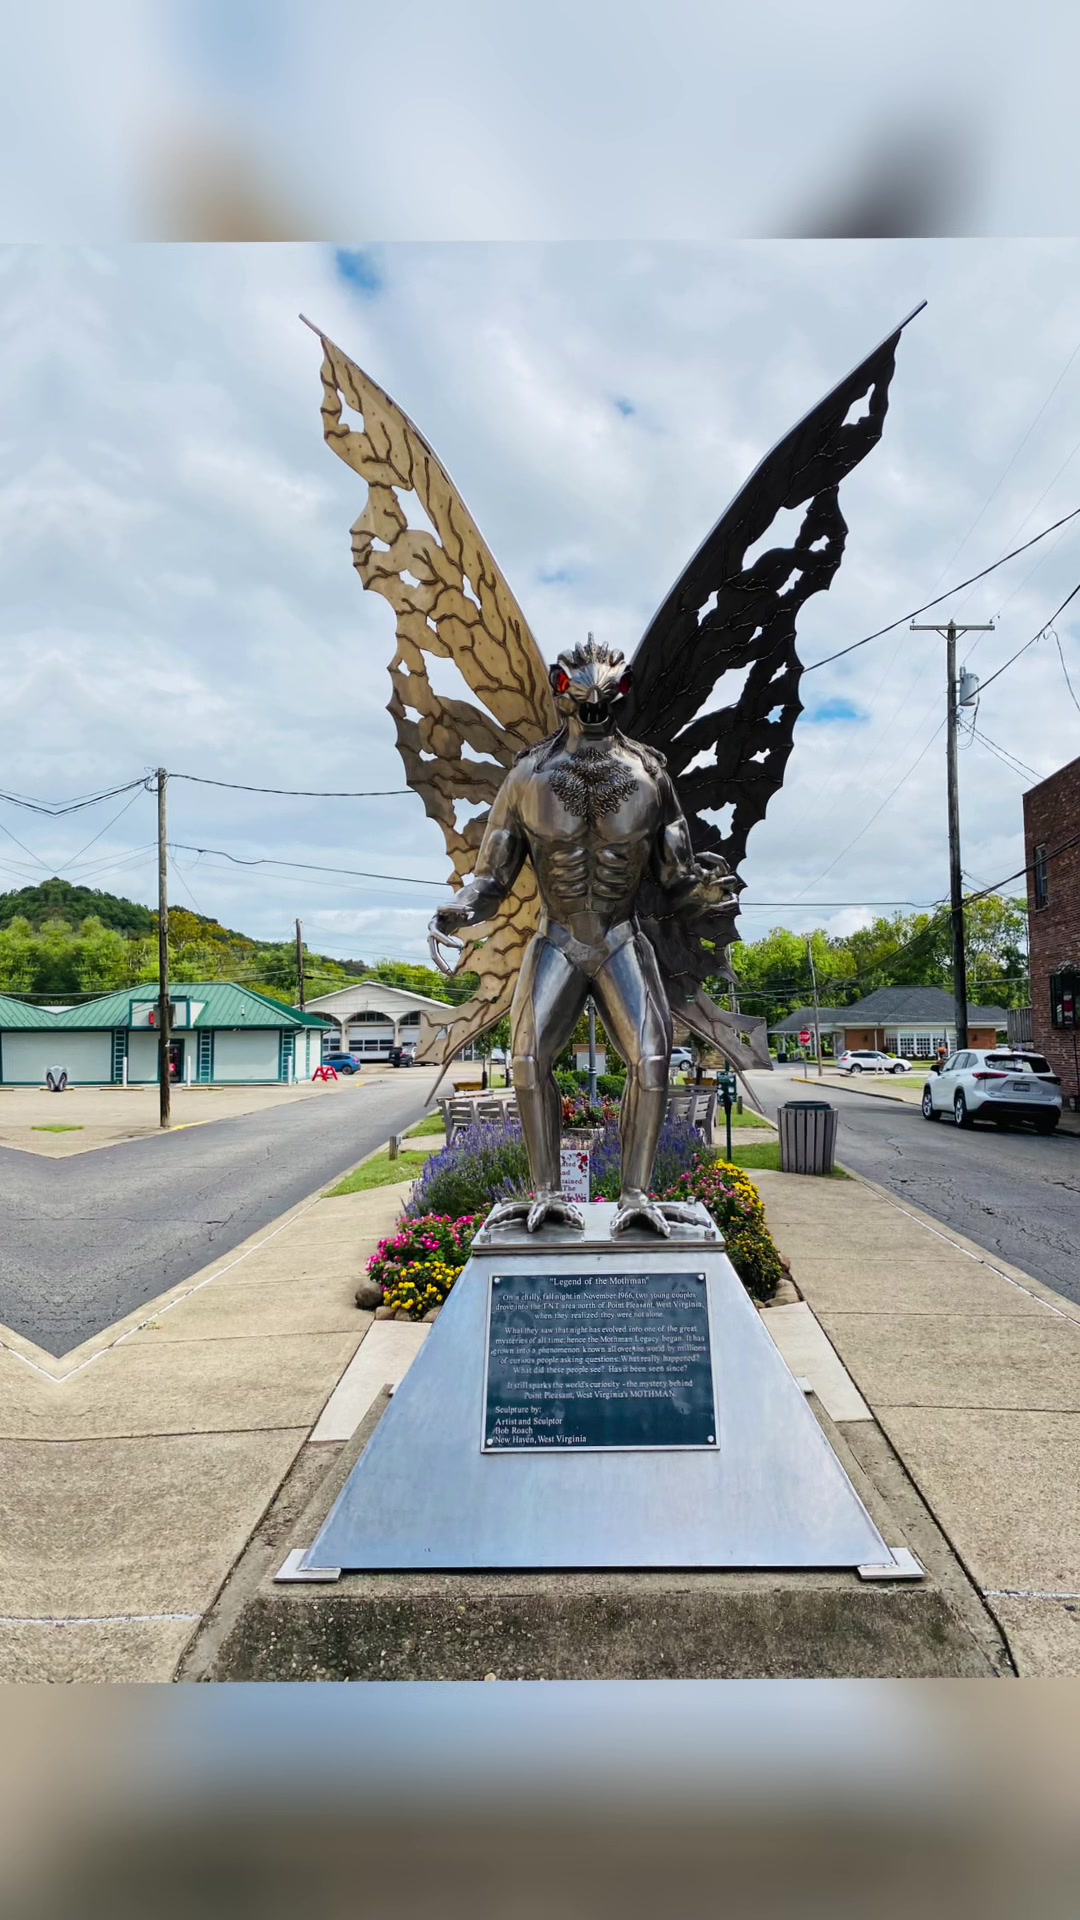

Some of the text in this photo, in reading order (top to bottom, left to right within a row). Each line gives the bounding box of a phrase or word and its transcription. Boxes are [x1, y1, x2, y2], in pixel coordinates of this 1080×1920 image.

[550, 1278, 581, 1287] "Legend
[610, 1277, 649, 1285] Mothman"
[521, 1293, 541, 1301] chilly,
[525, 1327, 538, 1335] they
[570, 1327, 587, 1335] night
[537, 1357, 558, 1365] people
[560, 1356, 582, 1364] asking
[640, 1355, 660, 1363] really
[663, 1354, 700, 1362] happened?
[566, 1366, 589, 1374] people
[529, 1381, 551, 1390] sparks
[590, 1380, 620, 1389] curiosity
[639, 1380, 666, 1388] mystery
[495, 1406, 541, 1414] Sculpture by:
[534, 1418, 562, 1426] Sculptor
[512, 1436, 536, 1444] Haven,
[556, 1435, 586, 1444] Virginia
